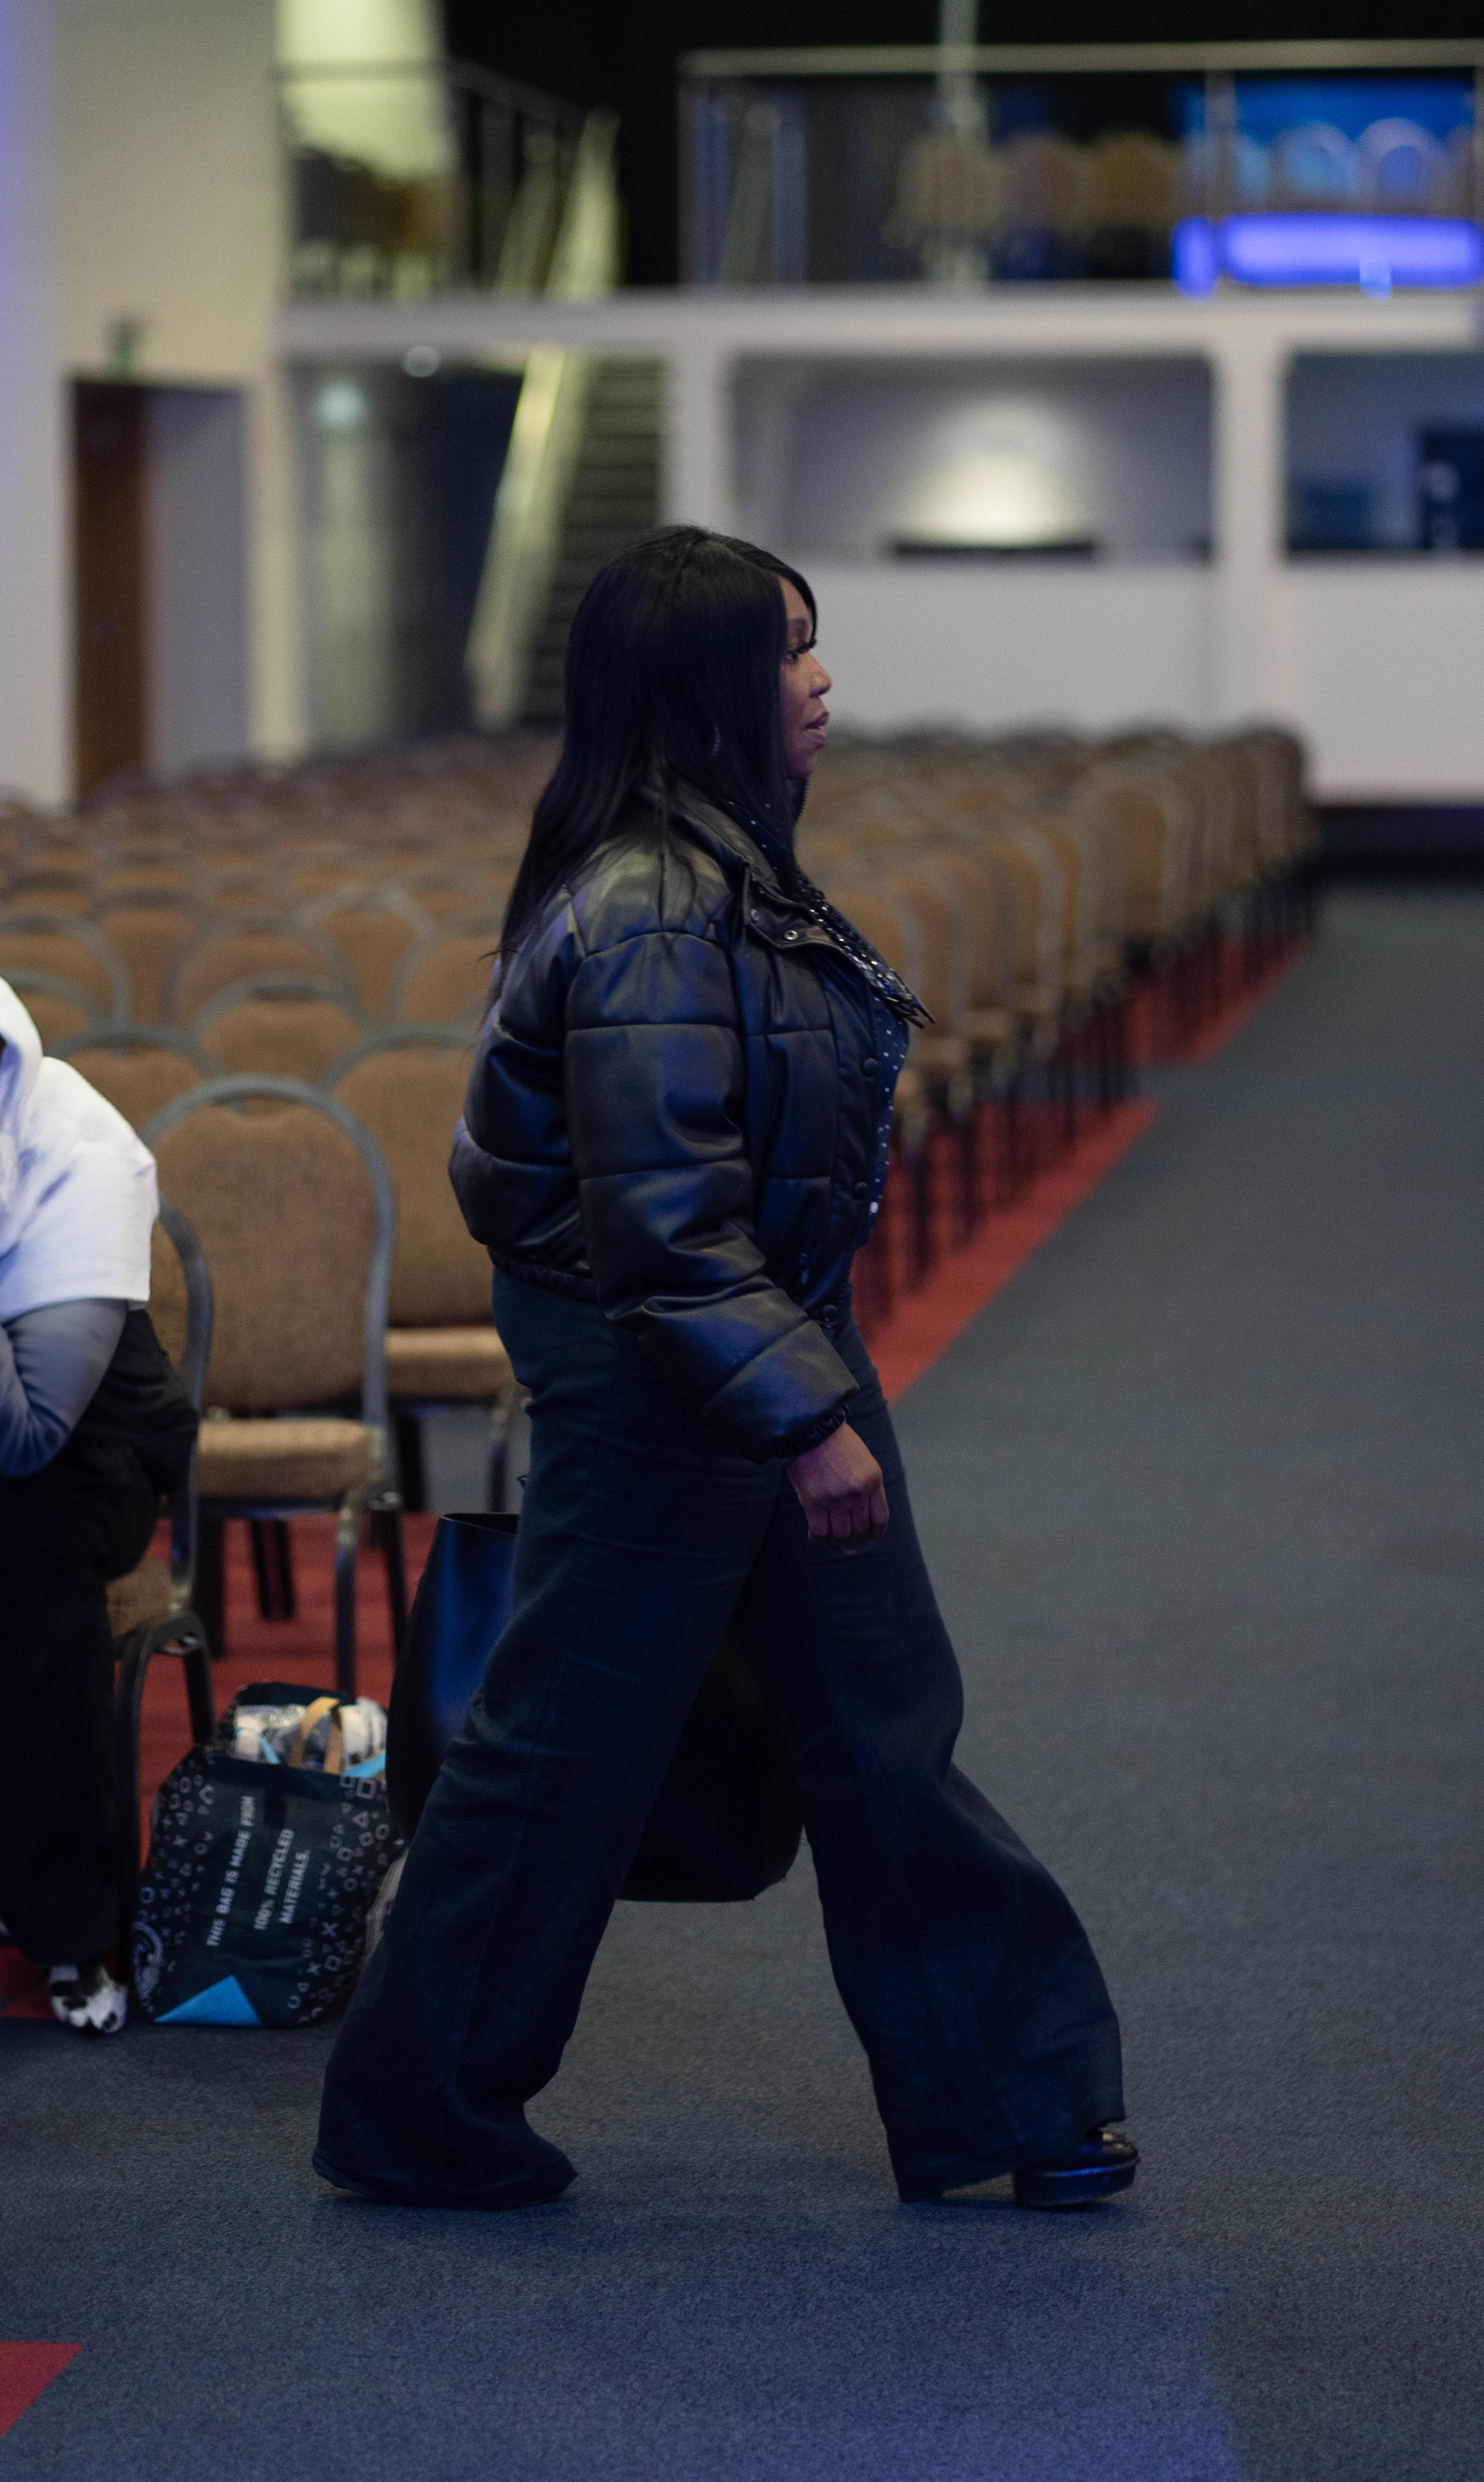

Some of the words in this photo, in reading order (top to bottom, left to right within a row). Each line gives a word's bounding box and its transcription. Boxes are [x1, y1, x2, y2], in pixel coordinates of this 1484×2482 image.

[229, 1830, 251, 1867] MADE
[264, 1829, 295, 1894] RECYCLED
[224, 1870, 239, 1883] IS
[216, 1887, 235, 1914] BAG
[206, 1919, 226, 1946] THIS
